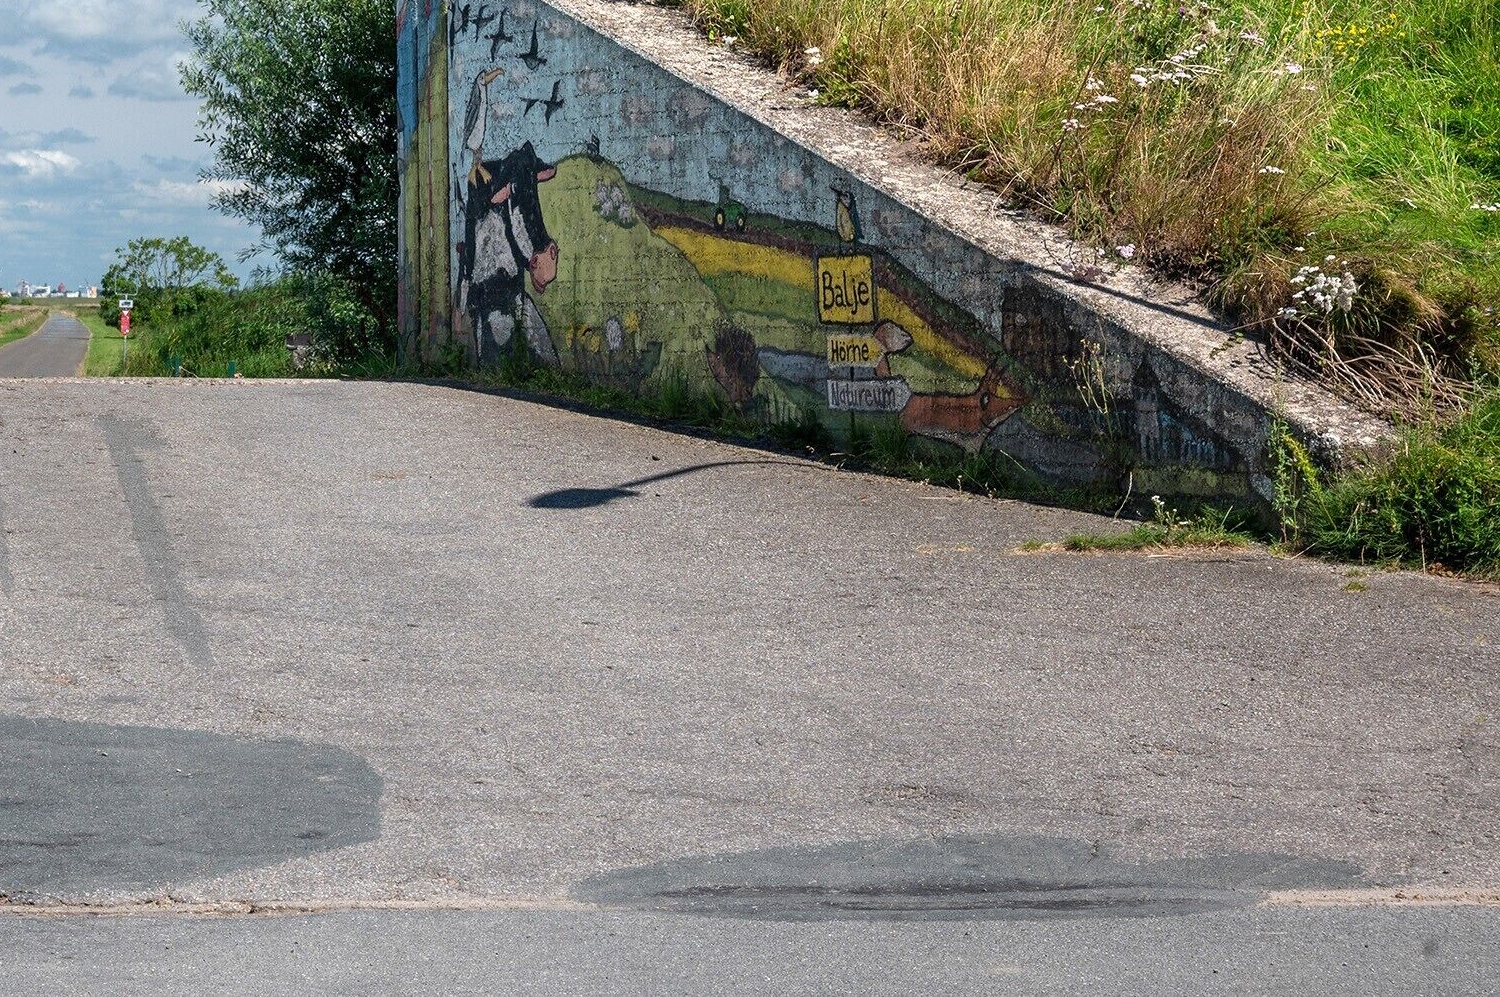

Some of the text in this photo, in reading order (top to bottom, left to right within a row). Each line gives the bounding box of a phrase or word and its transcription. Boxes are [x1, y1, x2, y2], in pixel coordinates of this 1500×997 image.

[822, 271, 870, 315] Balje
[830, 339, 870, 363] Hörne
[830, 382, 896, 406] Natureum
